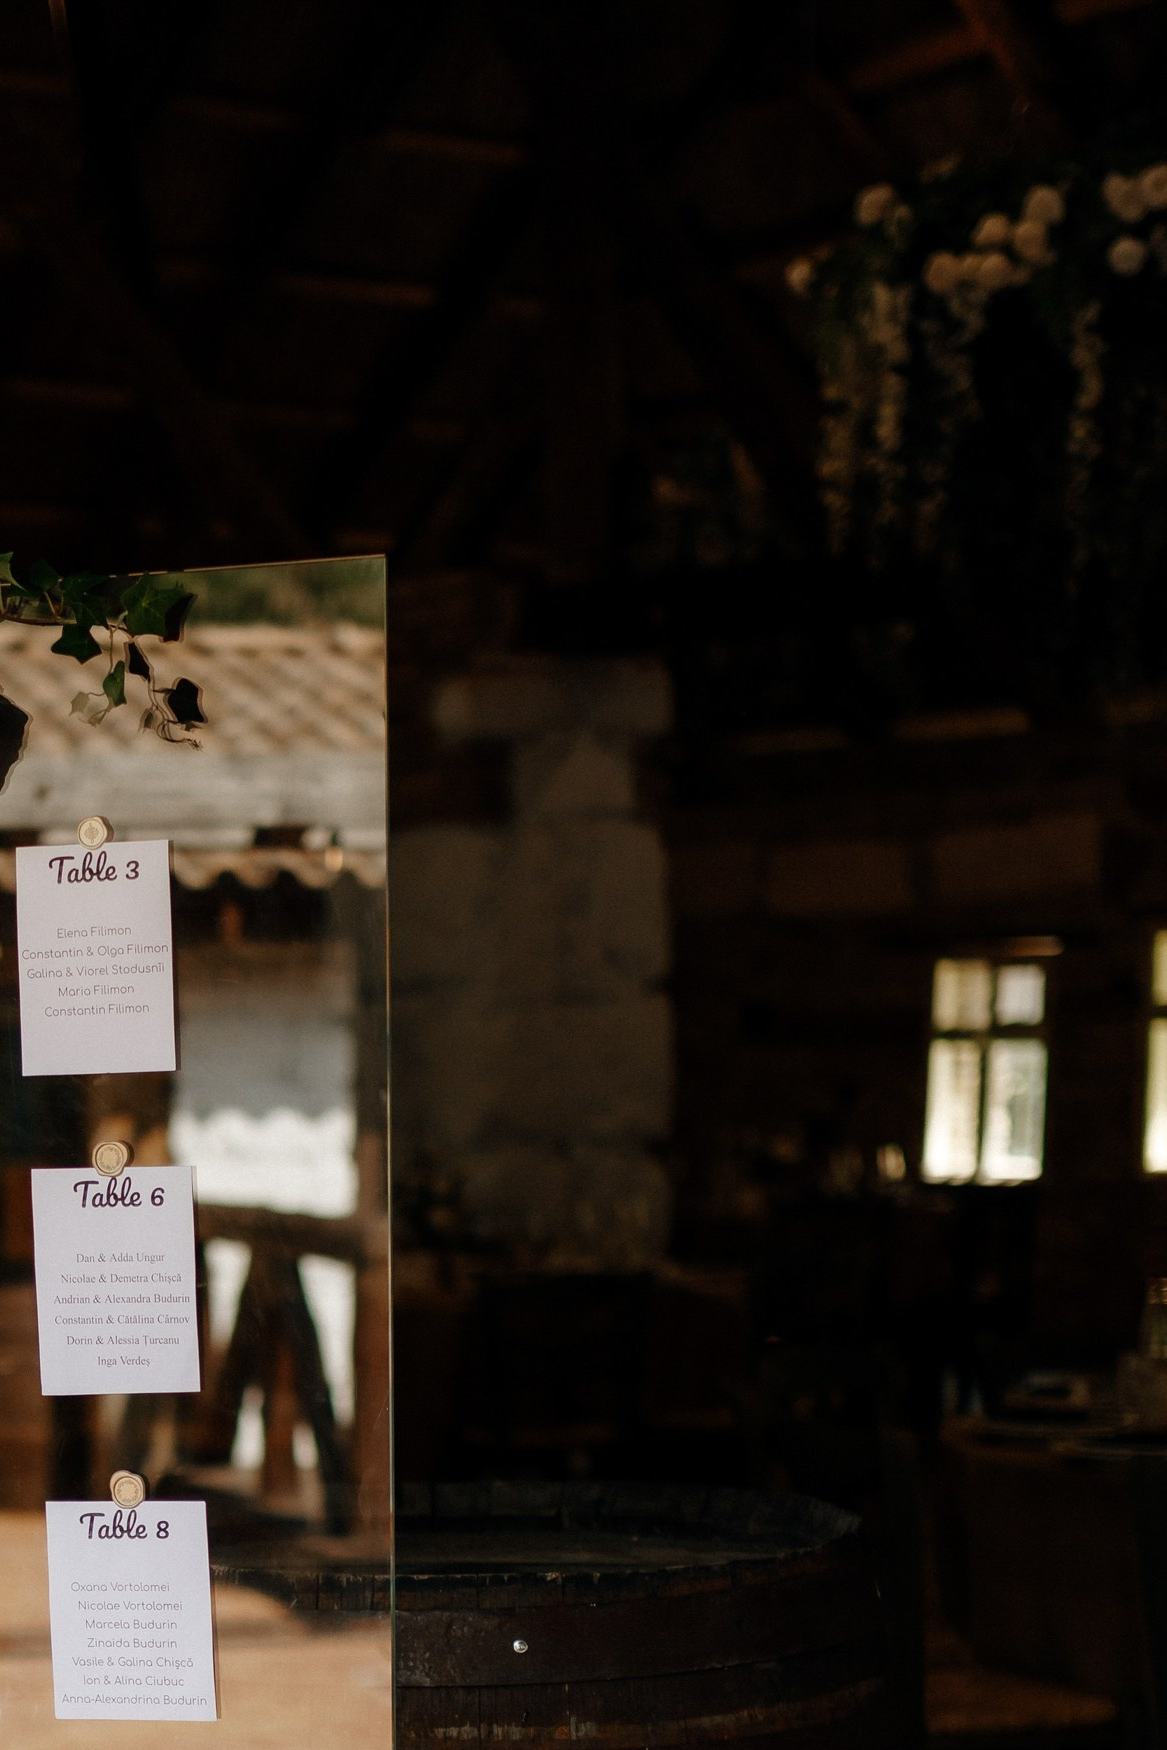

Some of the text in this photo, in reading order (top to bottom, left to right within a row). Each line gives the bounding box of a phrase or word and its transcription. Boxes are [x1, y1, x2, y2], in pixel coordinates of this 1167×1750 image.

[48, 850, 140, 884] Table 3
[57, 925, 132, 939] Elena Filimon
[21, 944, 169, 960] Constantin & Olga Filimon
[26, 968, 63, 980] Galina
[65, 967, 73, 977] &
[76, 965, 109, 977] Viorel
[58, 985, 135, 997] Maria Filimon
[44, 1003, 150, 1017] Constantin Filimon
[73, 1176, 165, 1208] Table 6
[76, 1253, 165, 1265] Dan & Adda Ungur
[60, 1274, 96, 1284] Nicolae
[99, 1273, 107, 1283] &
[110, 1273, 149, 1283] Demetra
[54, 1293, 191, 1305] Andrian & Alexandra Budurin
[54, 1315, 103, 1325] Constantin
[106, 1315, 115, 1325] &
[66, 1335, 93, 1346] Dorin
[96, 1335, 104, 1345] &
[107, 1334, 140, 1345] Alessia
[97, 1355, 117, 1368] Inga
[79, 1509, 170, 1539] Table 8
[71, 1582, 107, 1592] Oxana
[78, 1601, 120, 1611] Nicolae
[85, 1619, 178, 1630] Marcela Budurin
[87, 1638, 178, 1649] Zinaida Budurin
[71, 1656, 104, 1667] Vasile
[107, 1656, 114, 1666] &
[117, 1657, 153, 1668] Galina
[83, 1675, 102, 1686] Ion
[104, 1676, 111, 1686] &
[114, 1676, 142, 1686] Alina
[163, 1695, 208, 1706] Budurin
